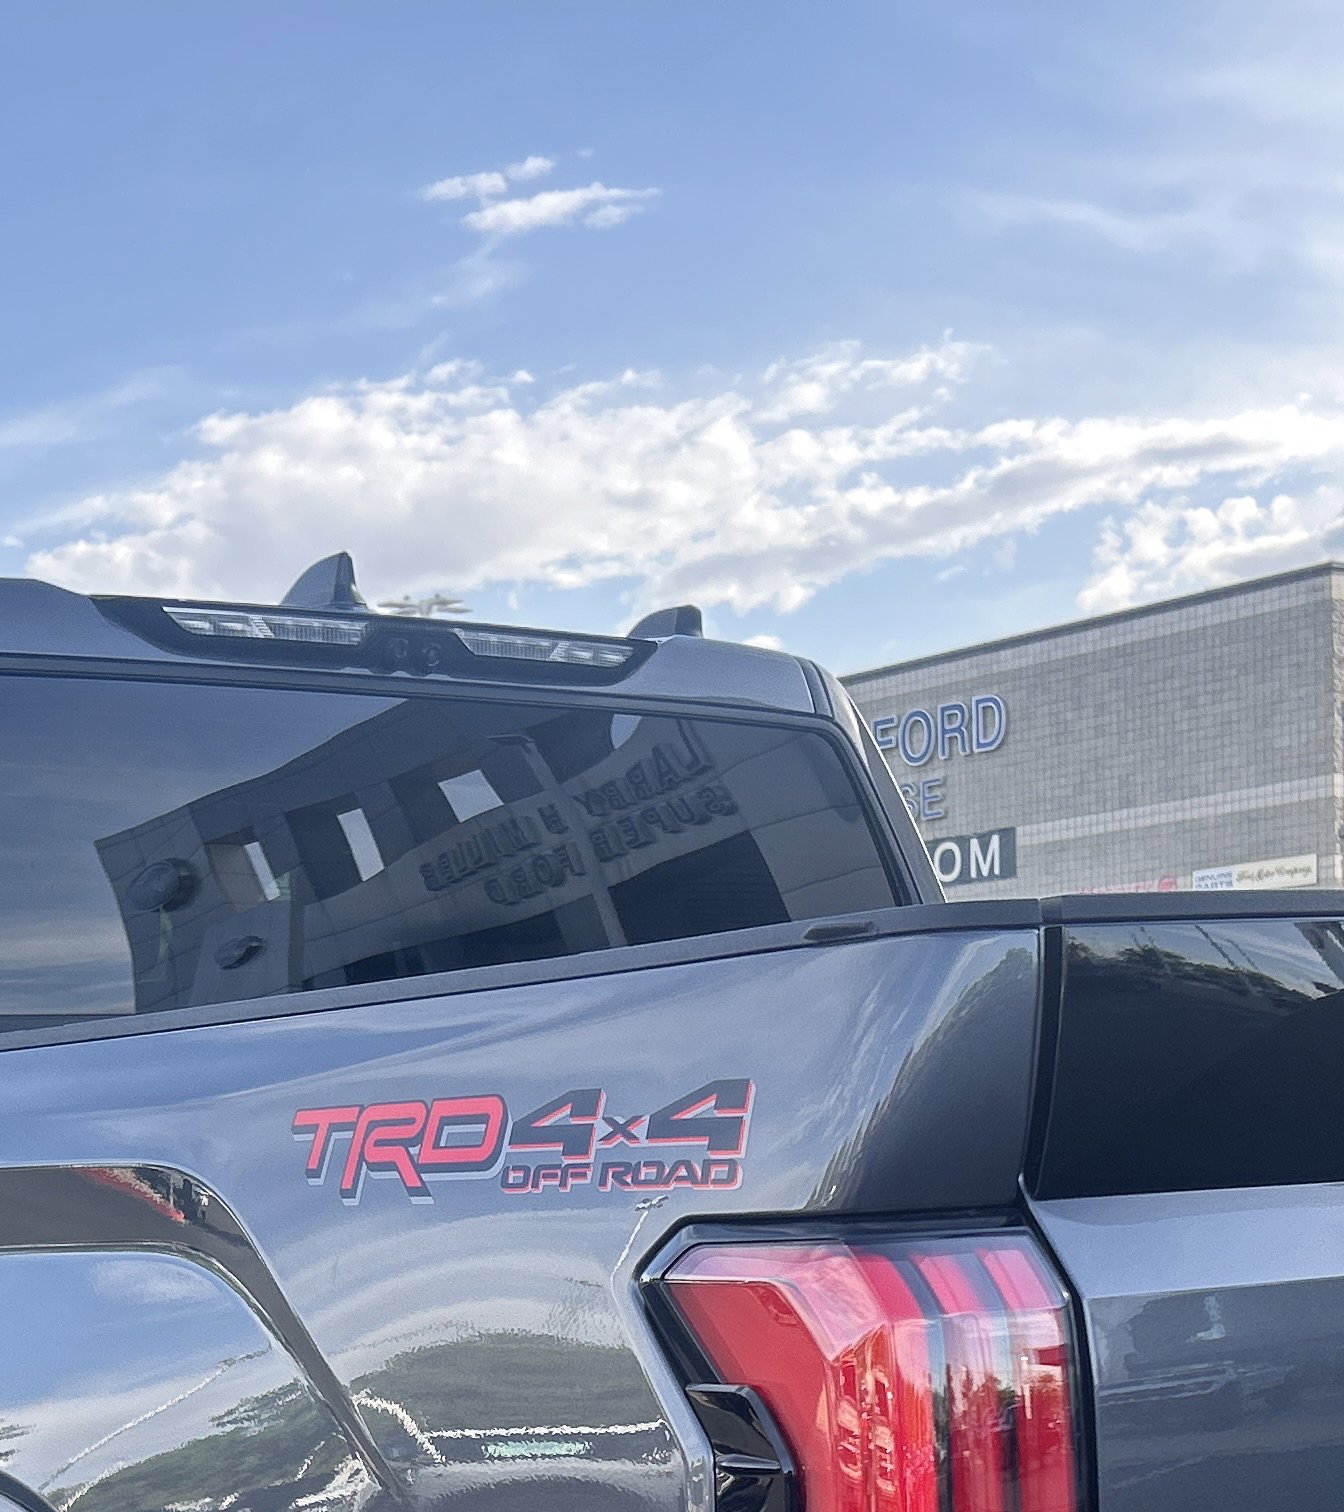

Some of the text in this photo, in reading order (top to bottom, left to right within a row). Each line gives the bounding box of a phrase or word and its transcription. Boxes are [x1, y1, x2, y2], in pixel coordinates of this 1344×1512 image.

[871, 694, 1006, 766] FORD
[291, 1093, 510, 1206] TRD
[500, 1157, 745, 1194] OFF ROAD
